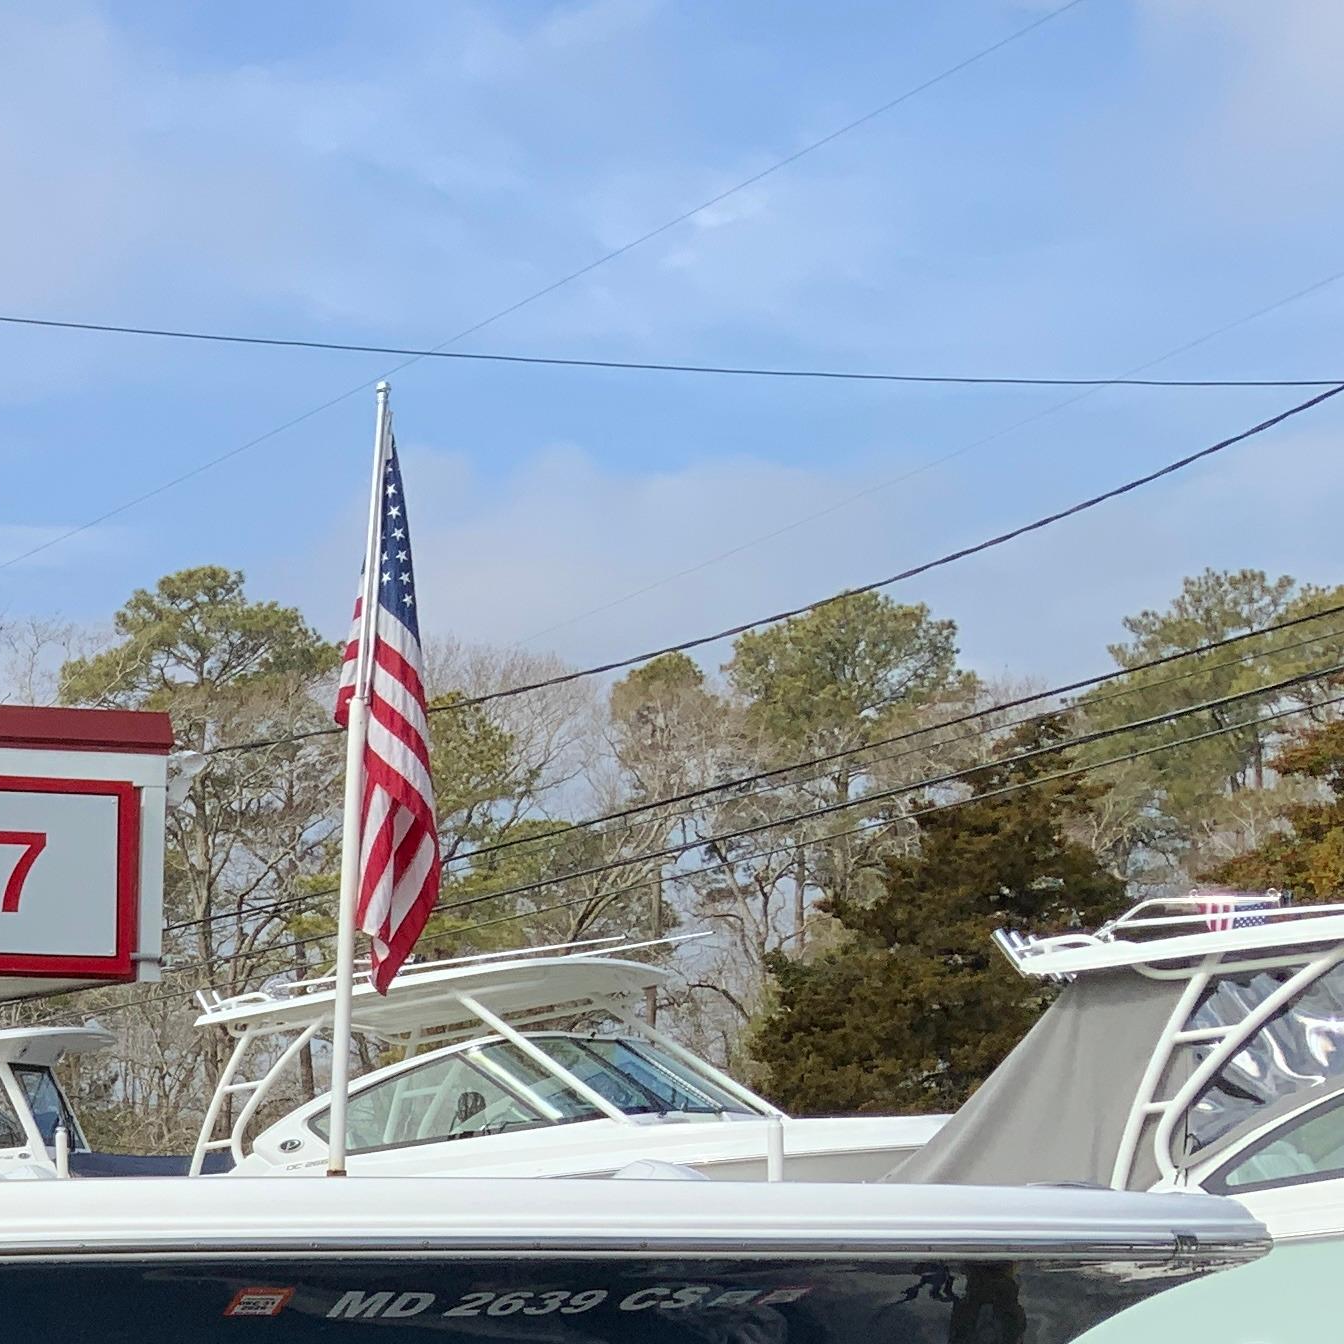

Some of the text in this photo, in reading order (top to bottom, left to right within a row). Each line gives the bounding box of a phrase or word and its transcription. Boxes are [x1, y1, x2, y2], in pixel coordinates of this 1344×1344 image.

[325, 1286, 711, 1318] MD 2639 CS
